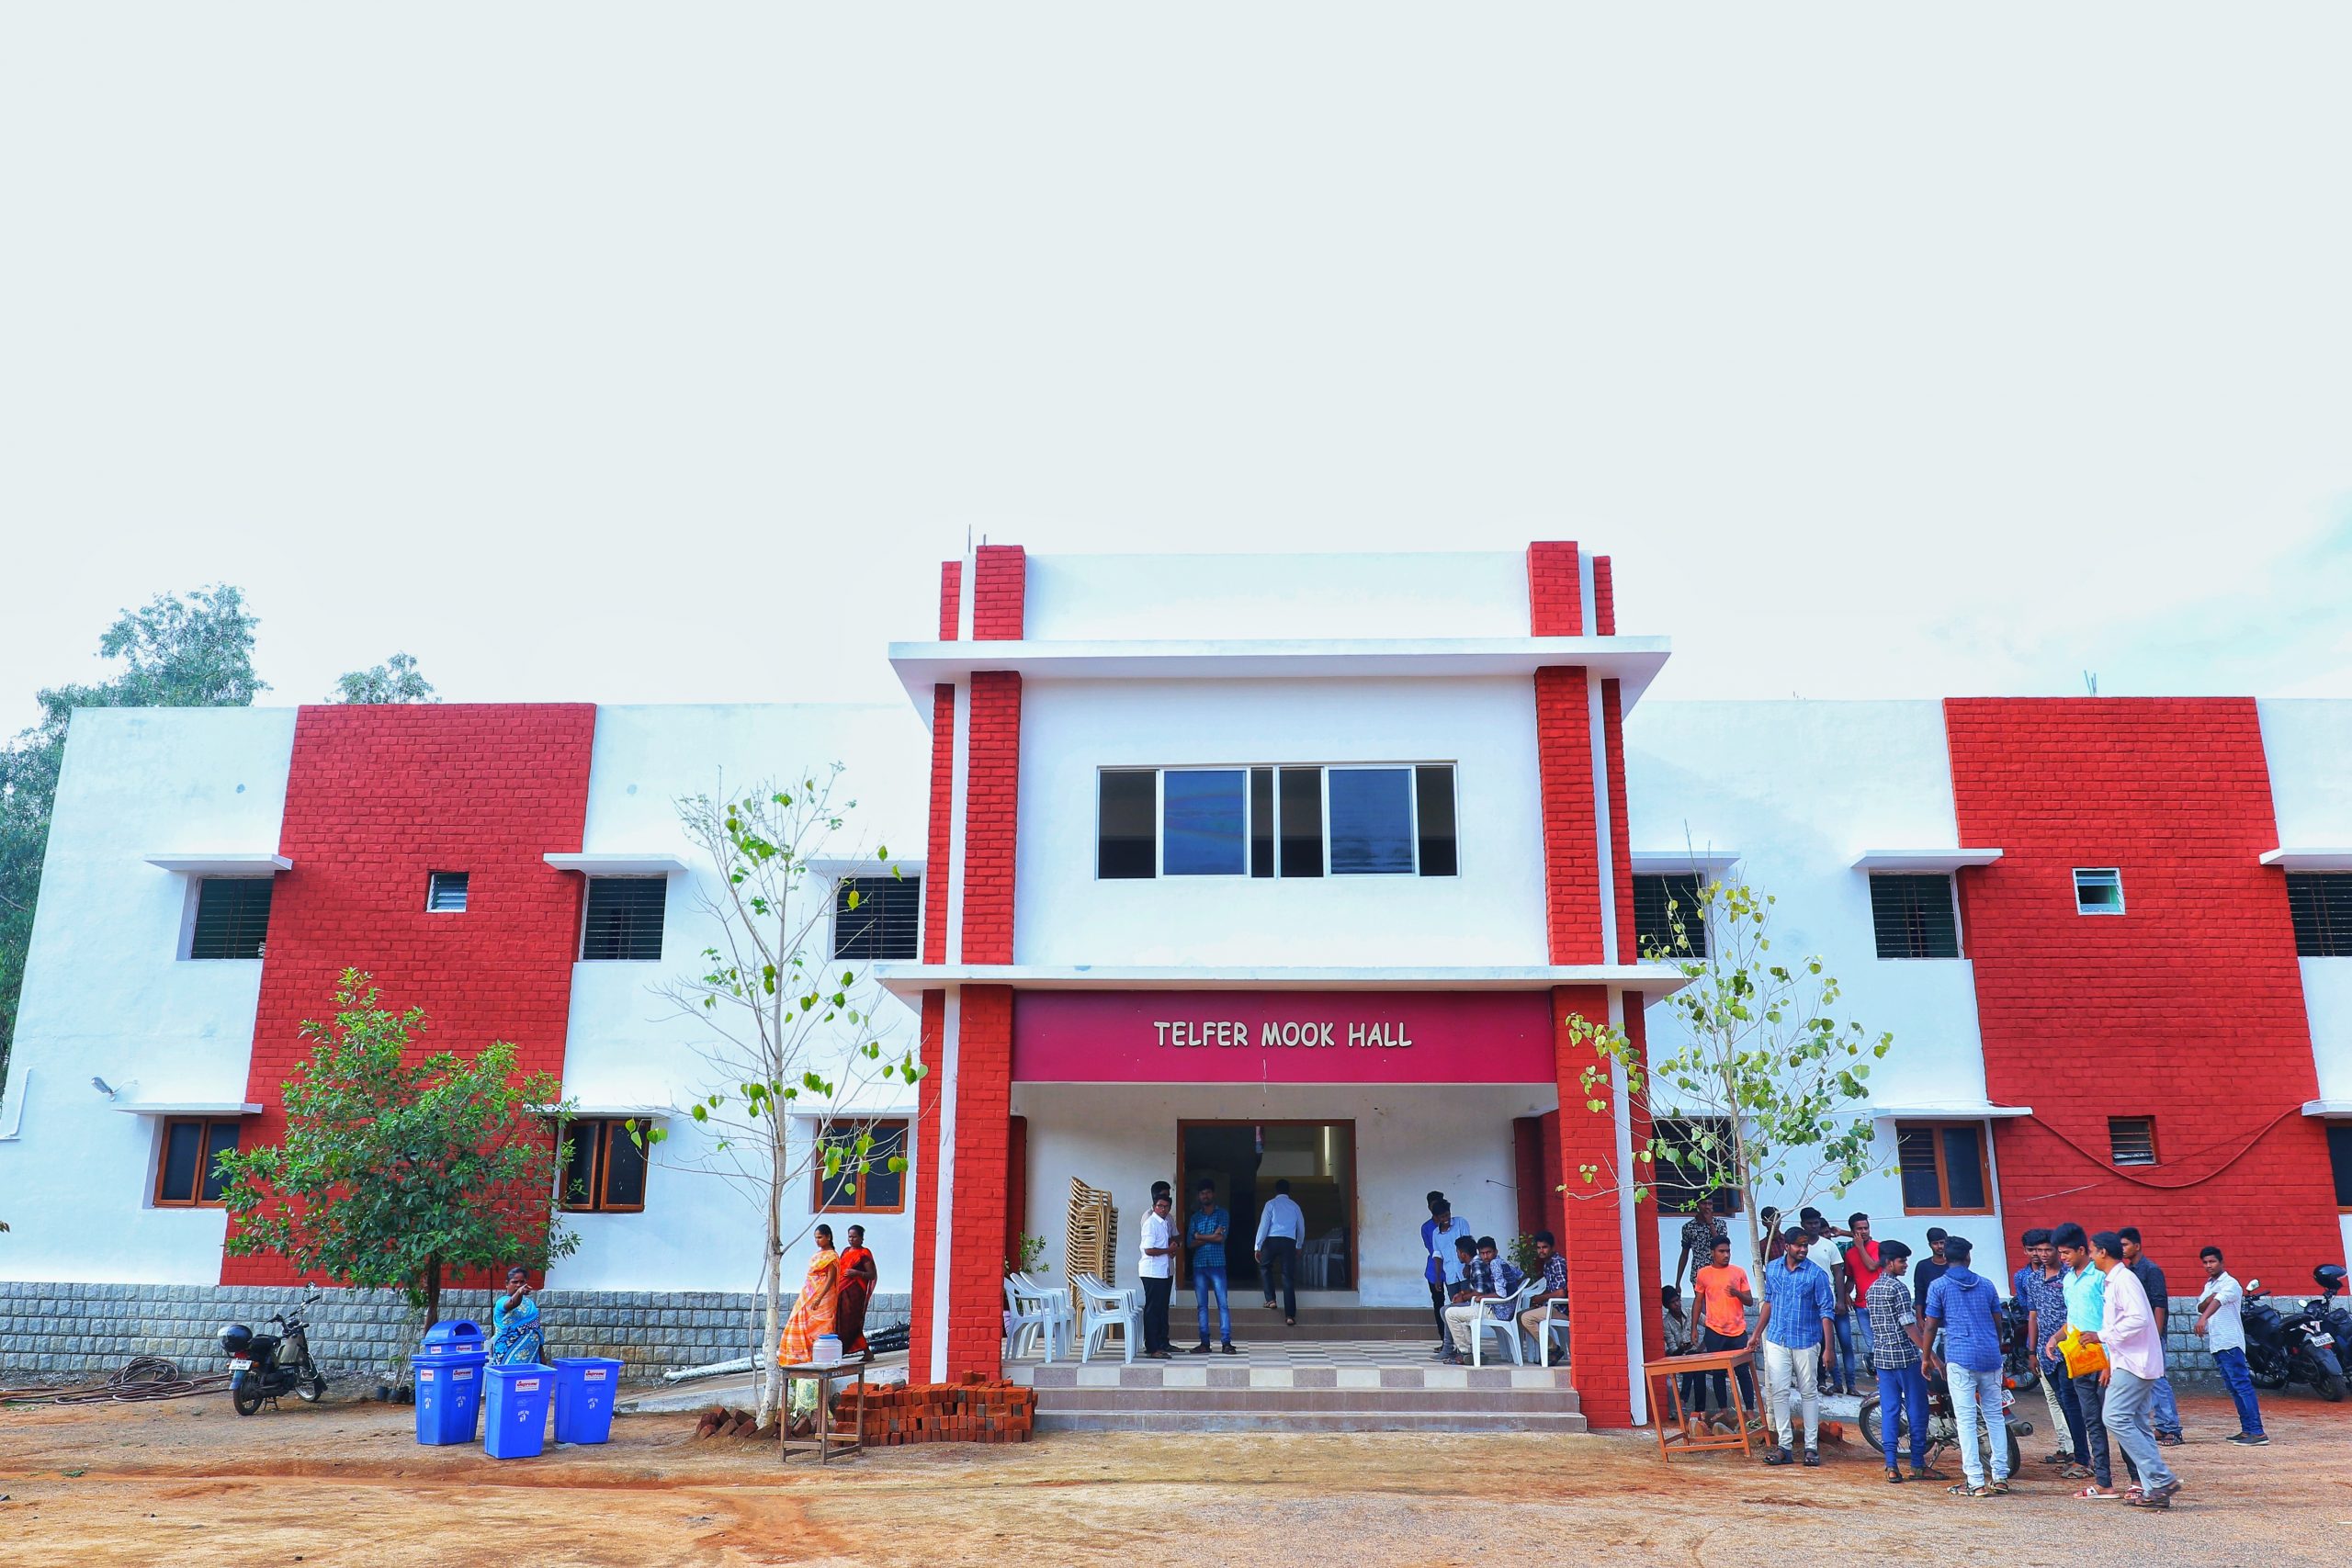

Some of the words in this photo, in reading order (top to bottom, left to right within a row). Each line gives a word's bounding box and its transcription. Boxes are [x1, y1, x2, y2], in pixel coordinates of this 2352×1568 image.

[1154, 1021, 1248, 1046] TELFER
[1261, 1021, 1335, 1047] MOOK
[1348, 1021, 1412, 1047] HALL
